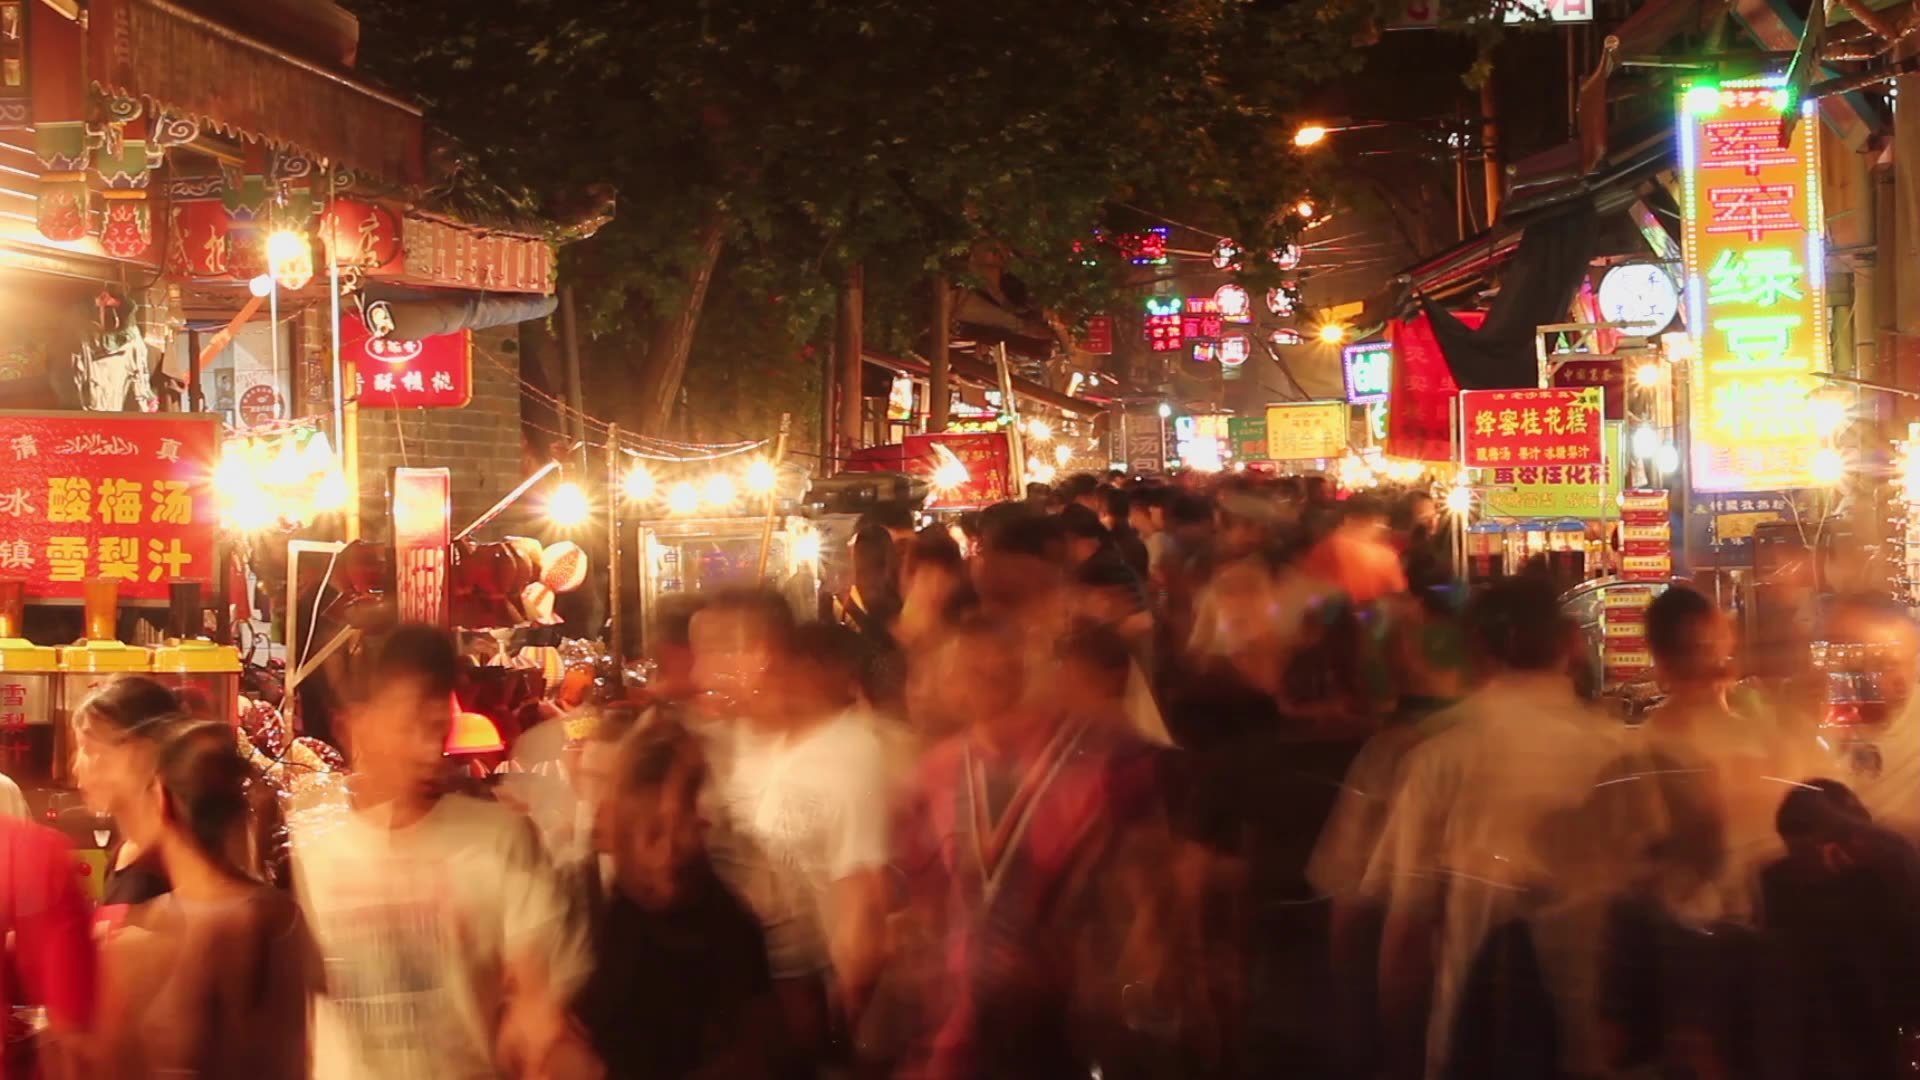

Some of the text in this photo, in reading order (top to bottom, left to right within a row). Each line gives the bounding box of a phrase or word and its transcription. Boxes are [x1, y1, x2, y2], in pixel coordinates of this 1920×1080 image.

[1475, 406, 1588, 438] 蜂蜜桂花糕
[10, 434, 183, 463] 清 真
[47, 477, 193, 525] 酸梅汤
[46, 536, 193, 583] 雪梨汁
